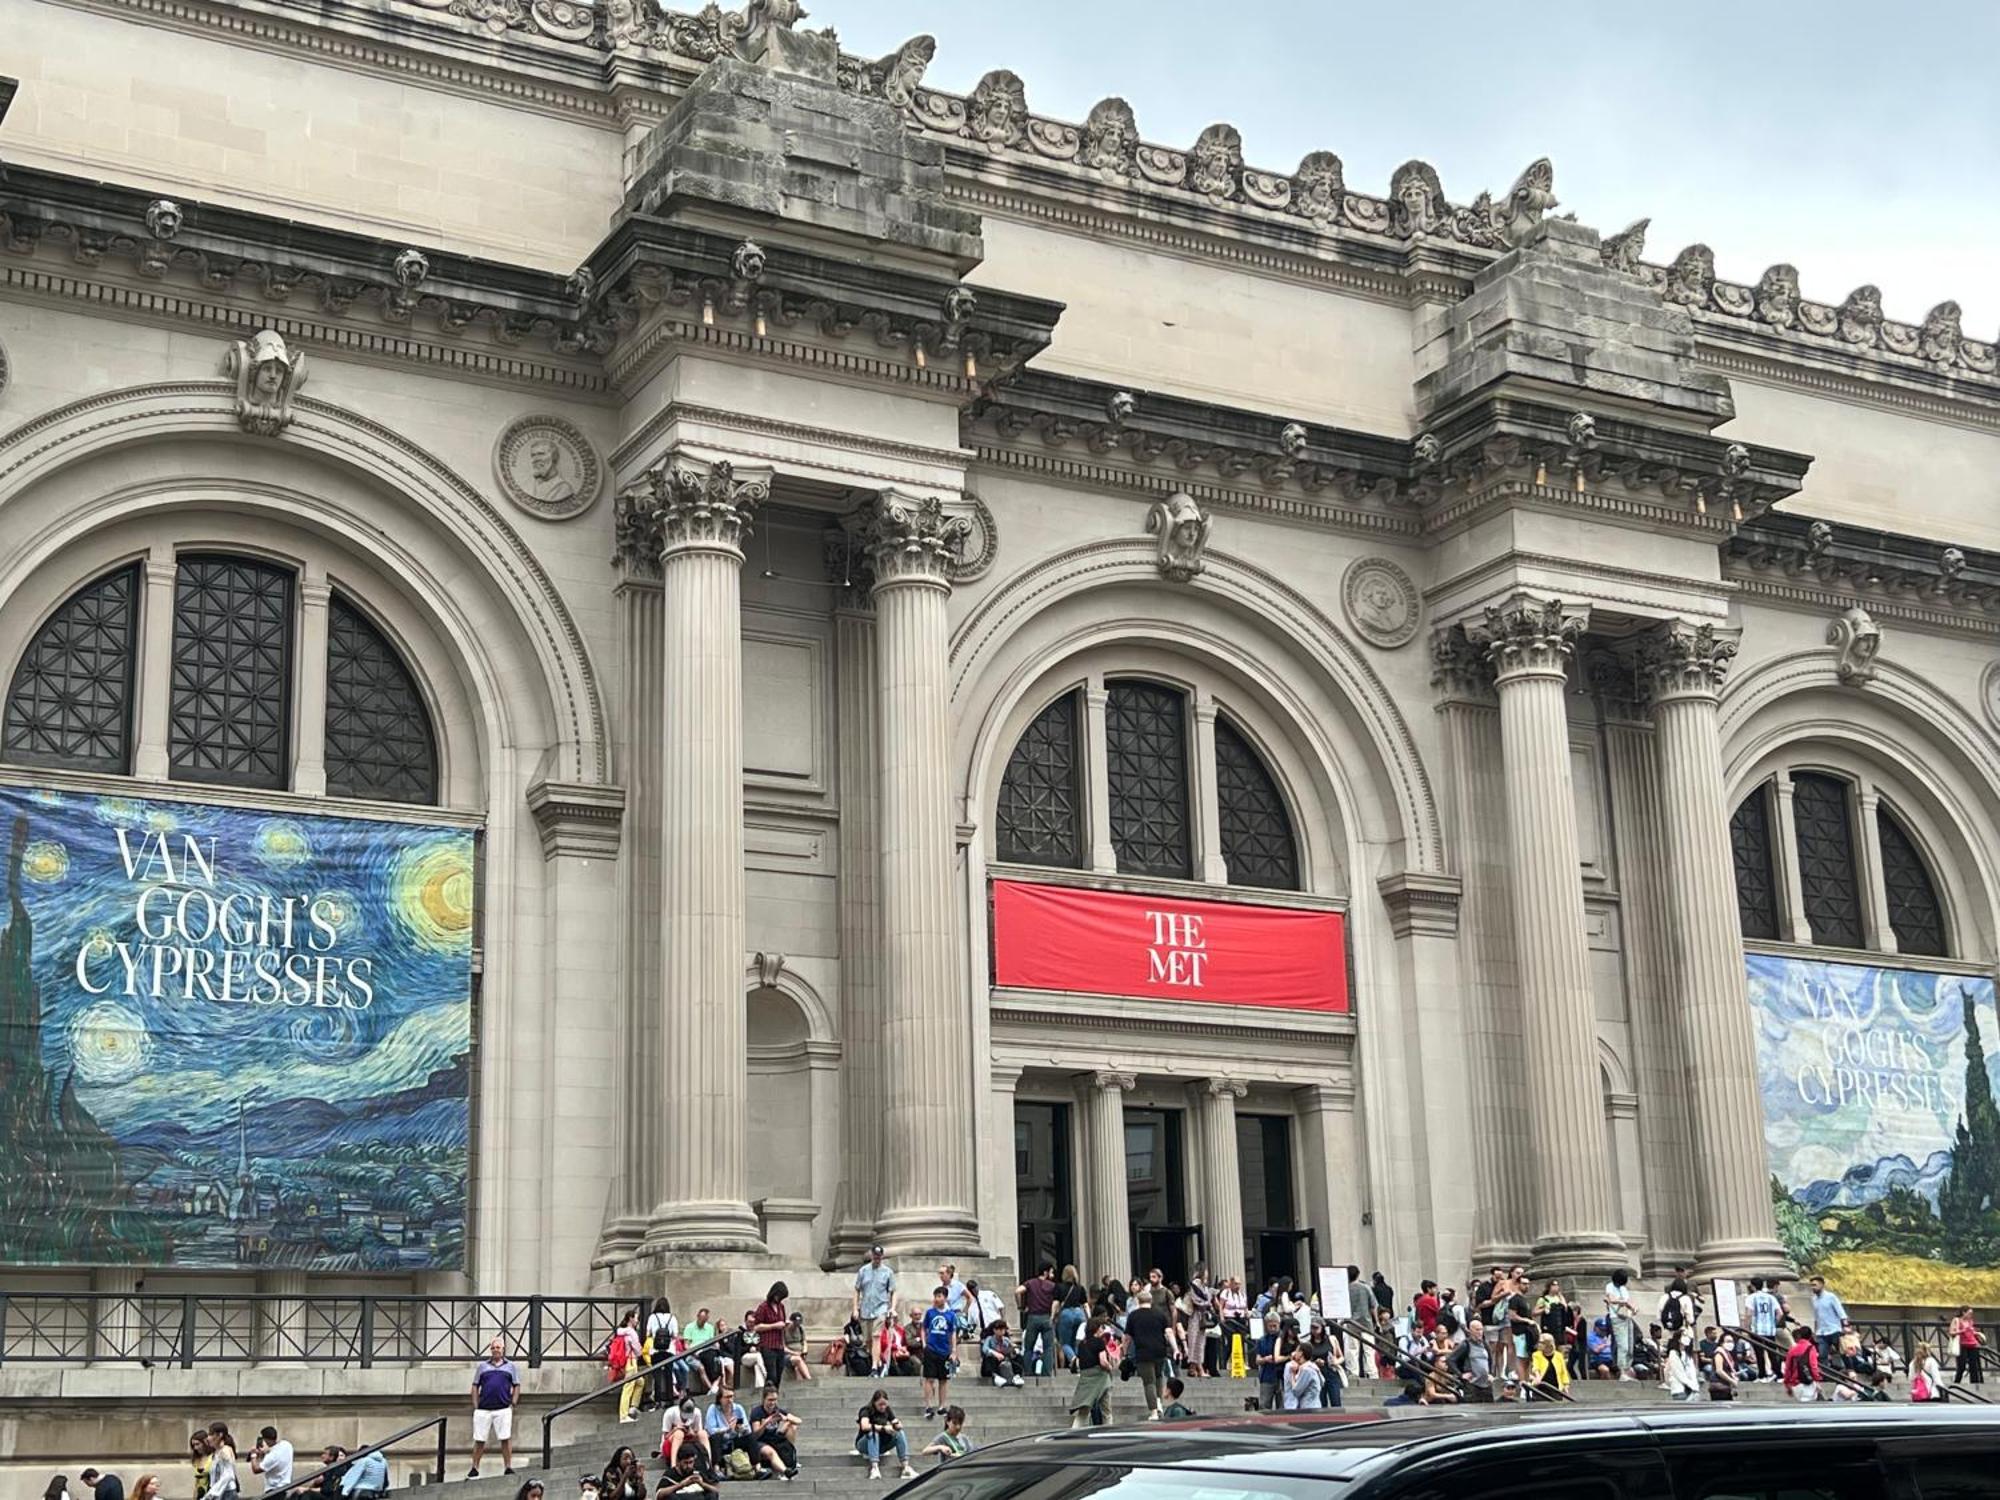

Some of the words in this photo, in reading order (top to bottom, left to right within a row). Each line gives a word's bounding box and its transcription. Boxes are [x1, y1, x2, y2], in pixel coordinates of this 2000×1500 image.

[114, 828, 218, 887] VAN
[136, 887, 337, 952] GOGH'S
[1145, 911, 1206, 949] THE
[76, 939, 374, 1010] CYPRESSES
[1147, 948, 1208, 987] MET
[1822, 1025, 1932, 1072] GOGH'S
[1797, 1064, 1957, 1114] CYPRESSES
